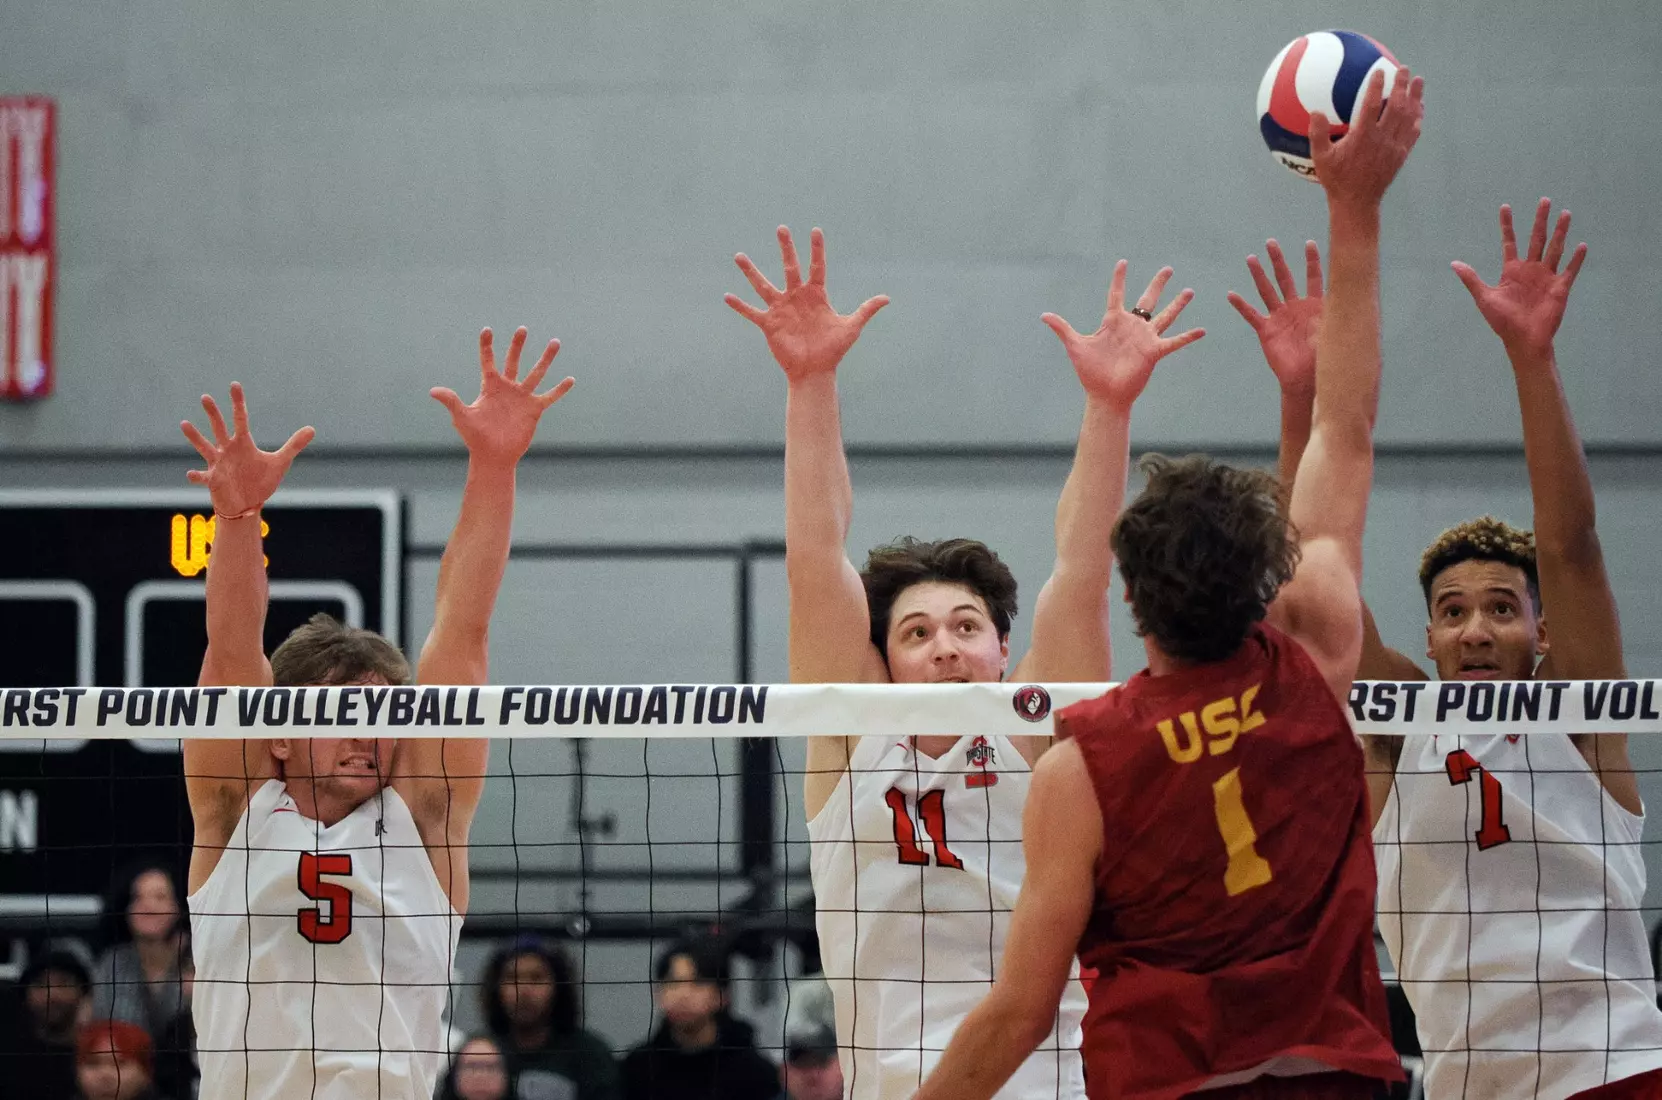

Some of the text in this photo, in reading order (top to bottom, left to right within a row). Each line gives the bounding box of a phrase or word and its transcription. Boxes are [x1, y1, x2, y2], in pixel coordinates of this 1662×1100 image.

[0, 685, 769, 727] RST POINT VOLLEYBALL FOUNDATION
[1435, 681, 1571, 722] POINT
[1583, 680, 1660, 721] VOL
[885, 786, 965, 871] 11
[1212, 766, 1273, 897] 1
[297, 851, 353, 944] 5
